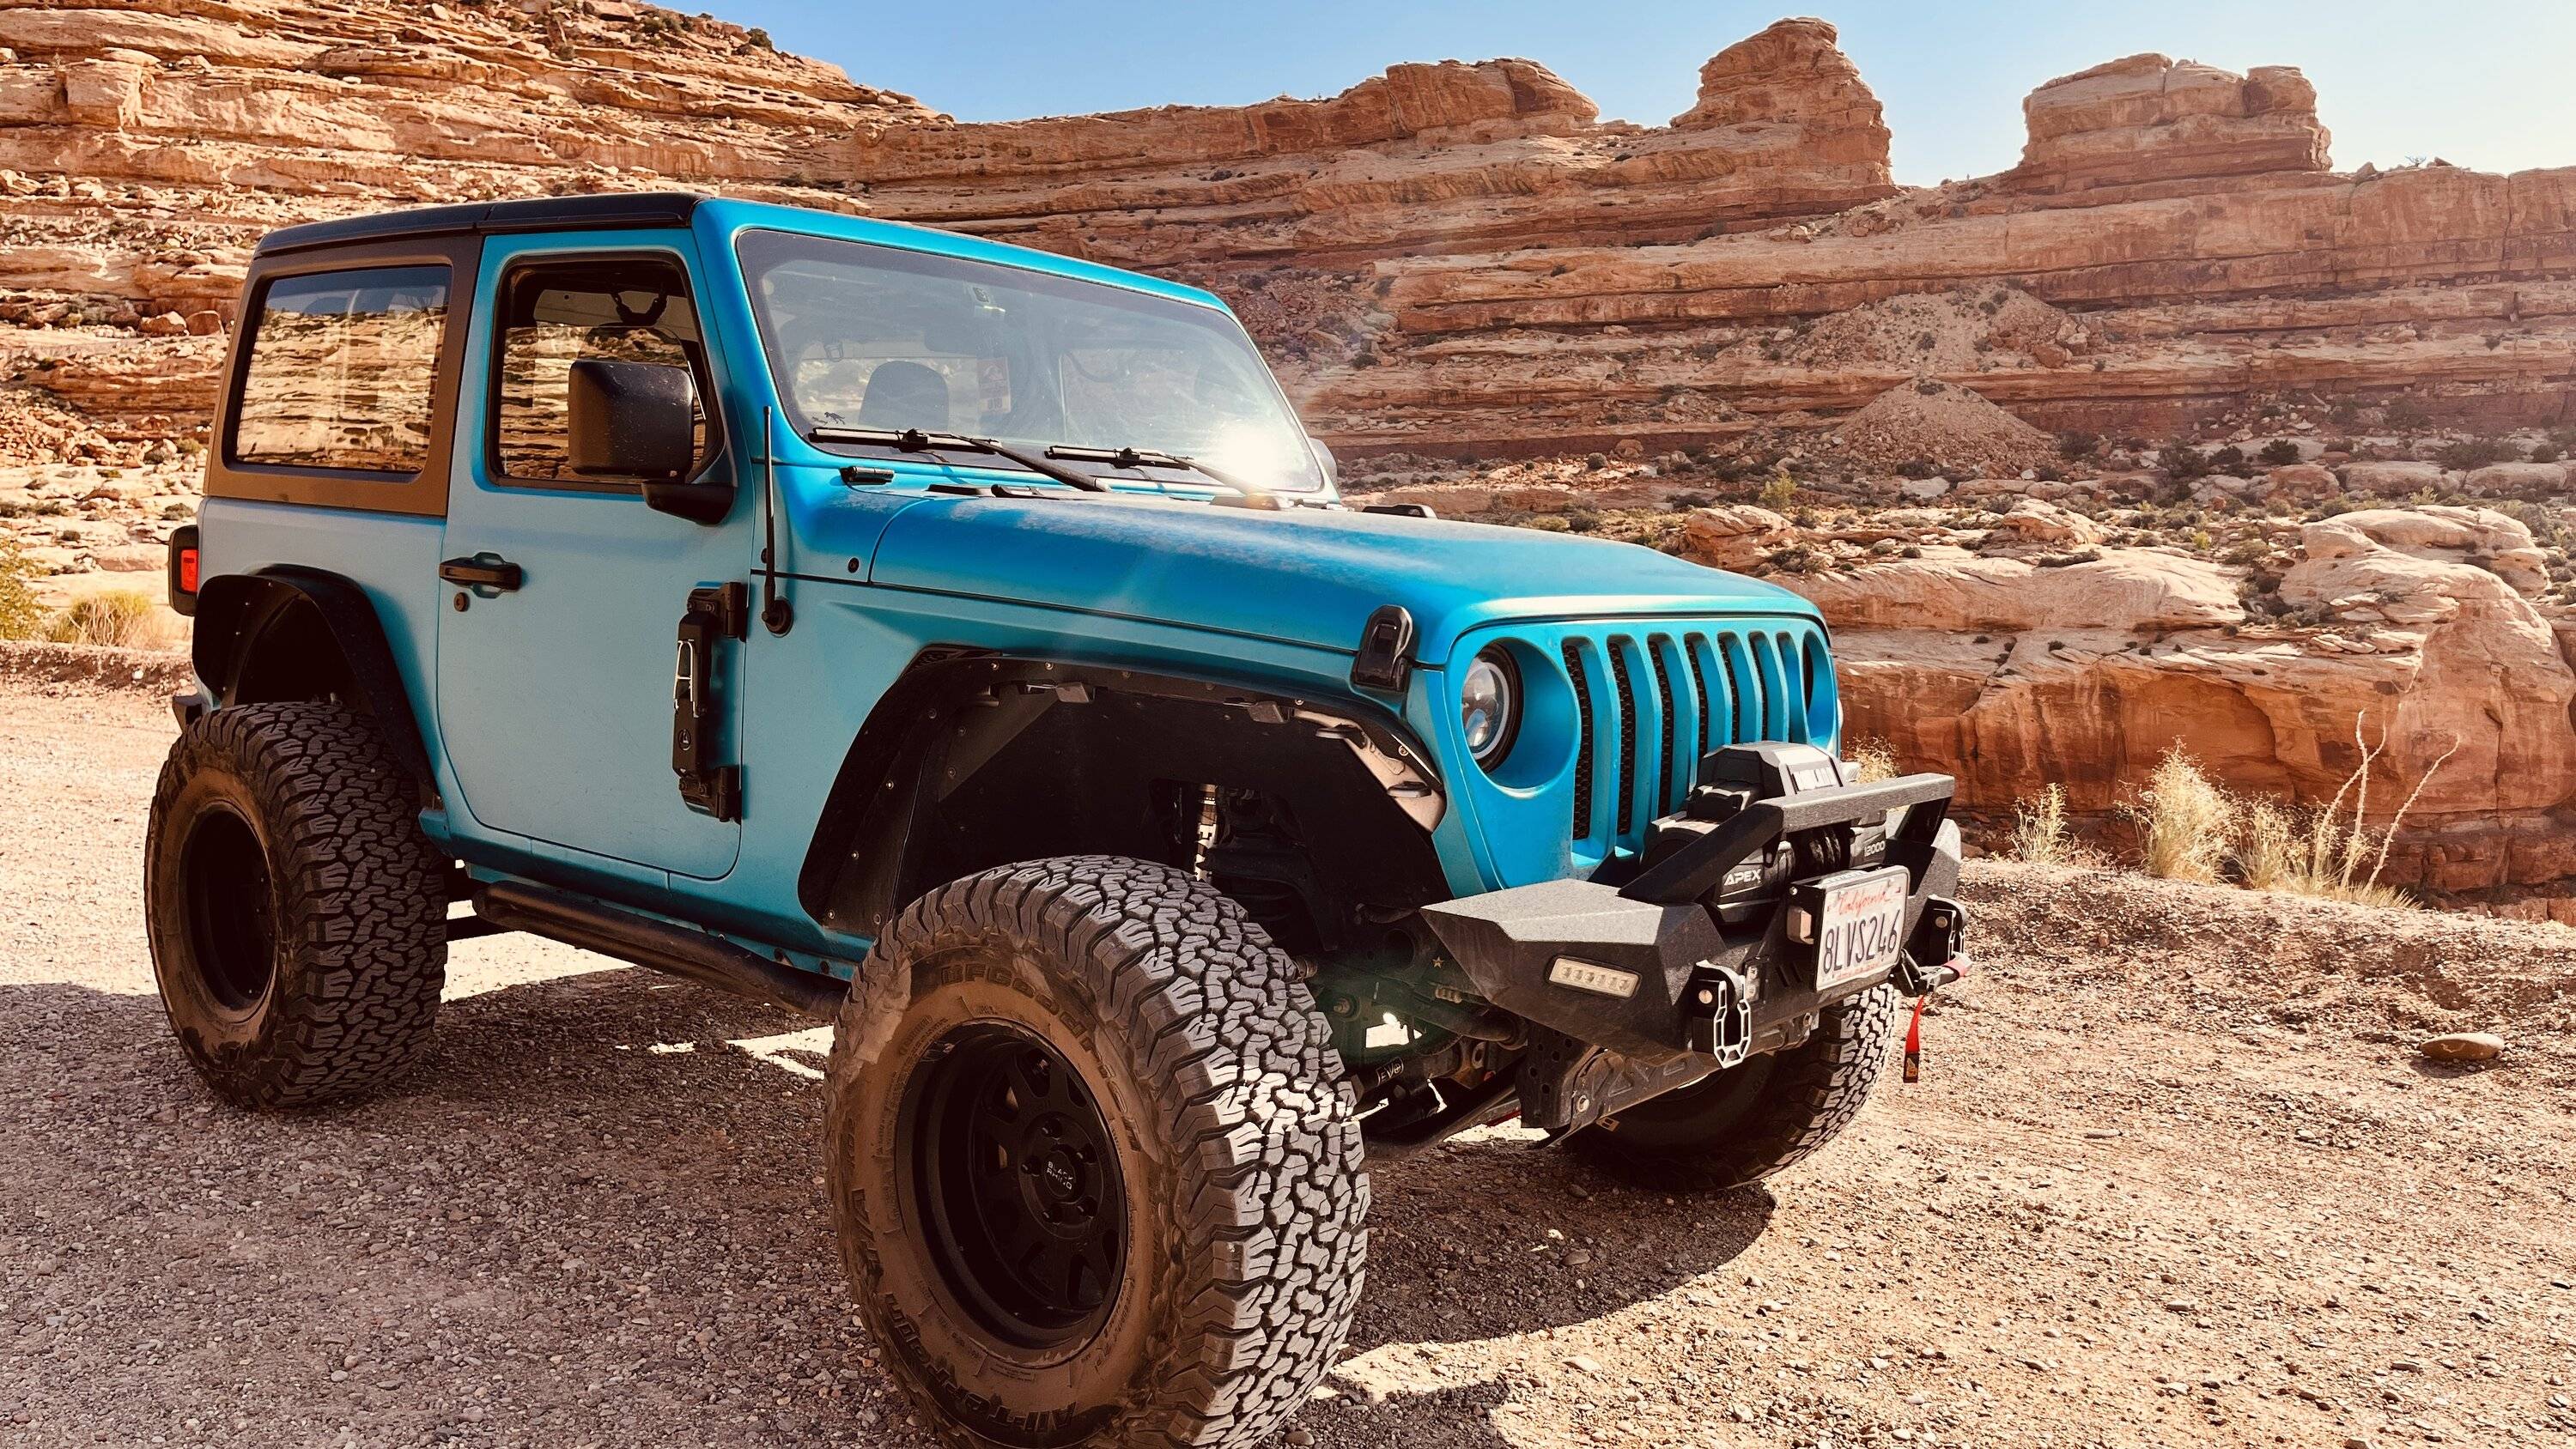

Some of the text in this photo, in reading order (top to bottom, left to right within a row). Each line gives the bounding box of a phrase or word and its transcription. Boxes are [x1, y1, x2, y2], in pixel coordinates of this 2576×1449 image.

[1863, 840, 1886, 858] 12000
[1724, 869, 1762, 886] APEX
[1823, 908, 1900, 974] 8LVS246
[1047, 1167, 1072, 1190] RHINO
[1048, 1161, 1074, 1180] BLACK
